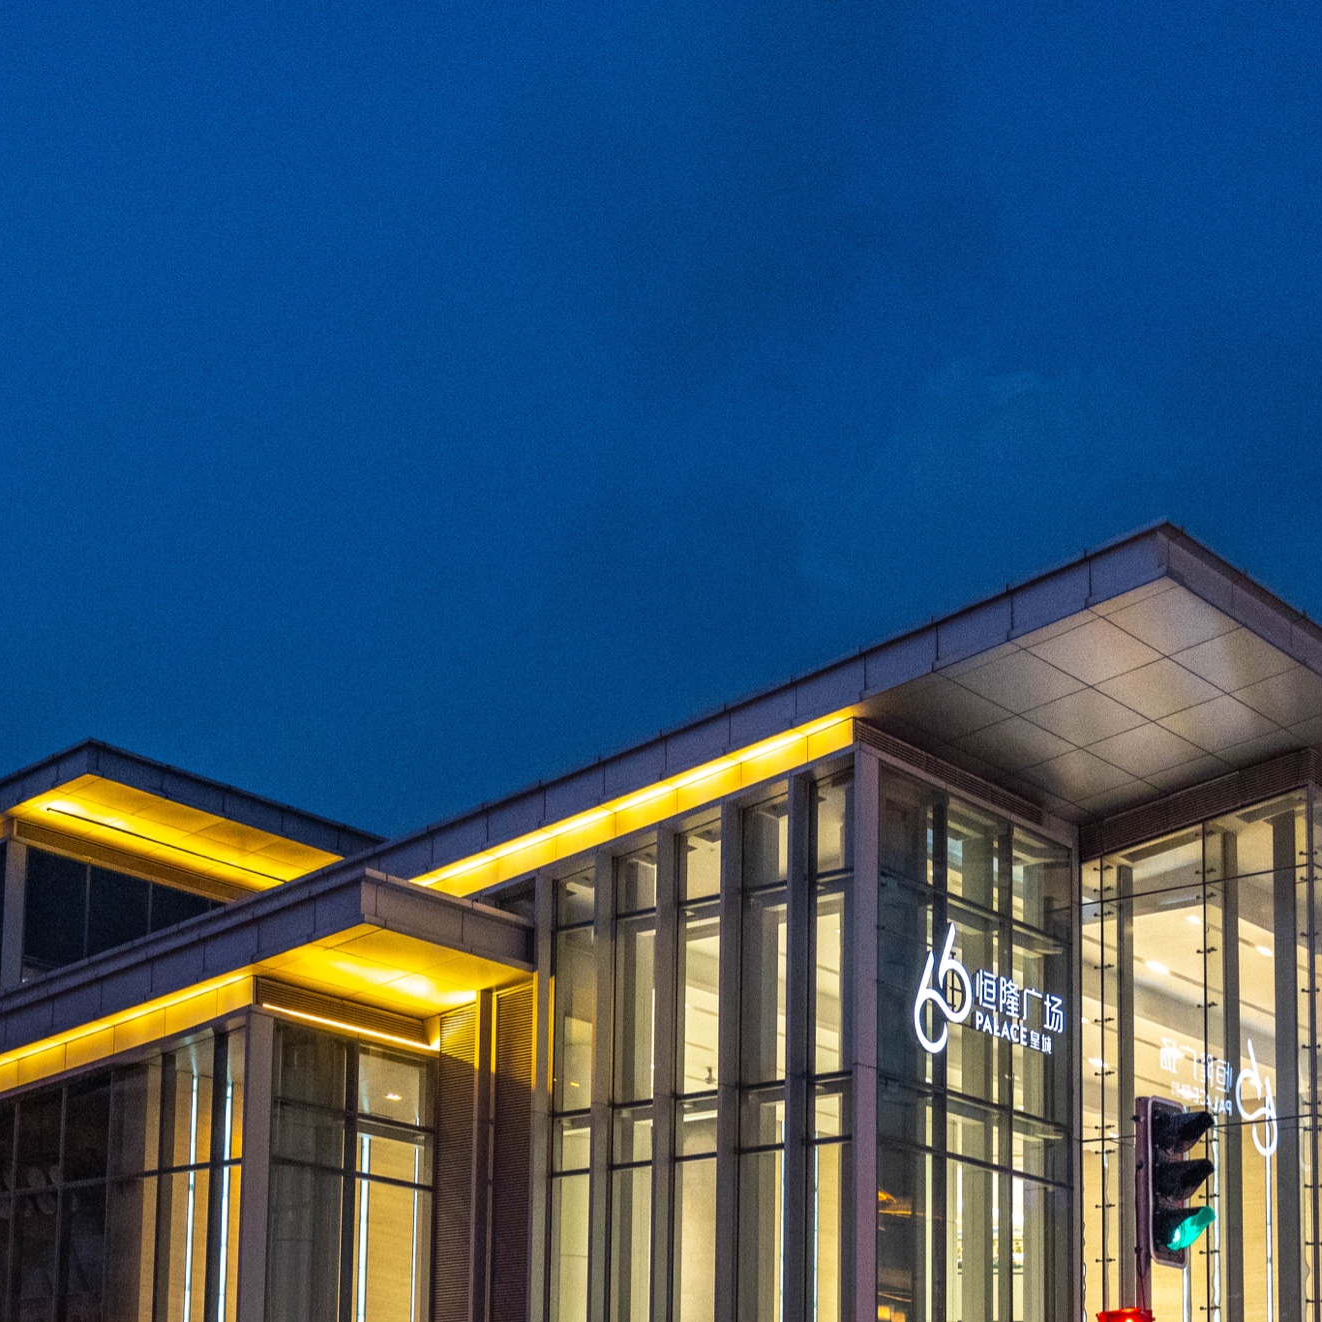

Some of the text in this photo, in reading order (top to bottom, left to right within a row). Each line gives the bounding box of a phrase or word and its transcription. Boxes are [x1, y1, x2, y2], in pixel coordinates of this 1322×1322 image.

[975, 969, 1065, 1033] 恒隆广场
[975, 1010, 1052, 1054] PALACE 皇城
